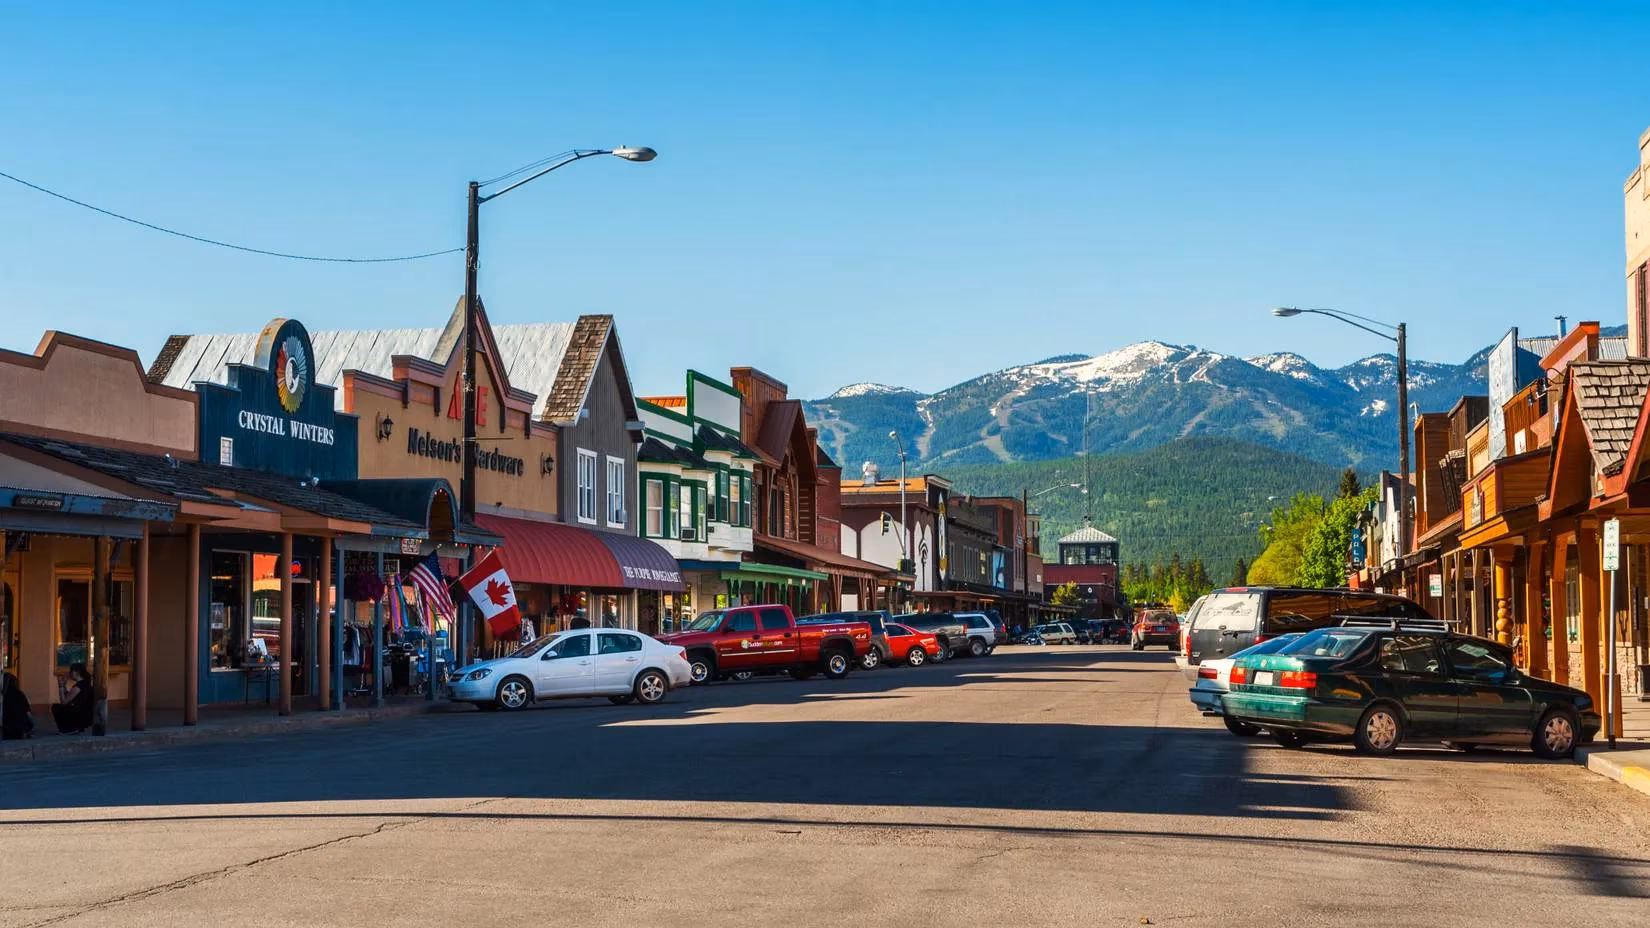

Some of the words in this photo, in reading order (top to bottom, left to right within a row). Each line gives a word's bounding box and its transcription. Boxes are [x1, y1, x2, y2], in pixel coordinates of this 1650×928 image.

[447, 371, 489, 427] AE
[238, 410, 285, 436] CRYSTAL
[290, 420, 334, 446] WINTERS
[407, 427, 461, 464] Nelson's
